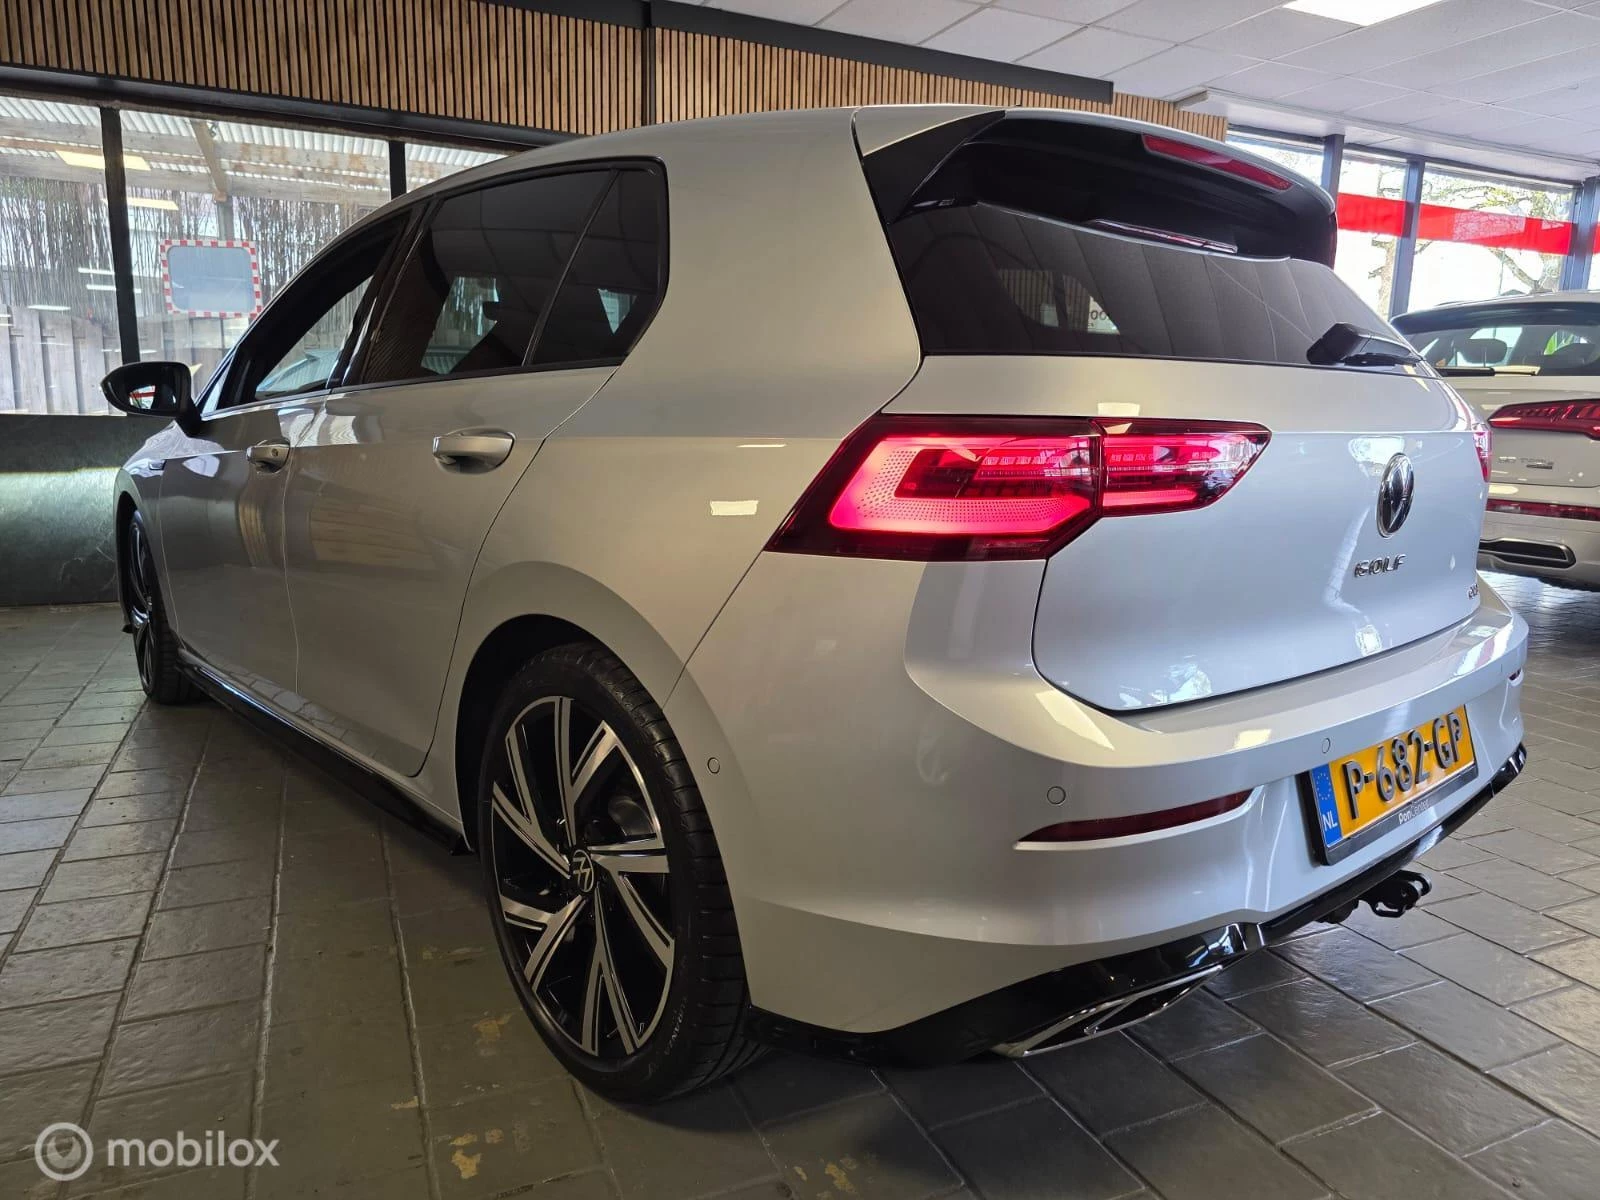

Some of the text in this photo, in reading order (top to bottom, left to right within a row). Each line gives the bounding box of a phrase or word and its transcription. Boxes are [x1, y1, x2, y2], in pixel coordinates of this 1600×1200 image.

[1354, 554, 1407, 578] GOLF
[1343, 711, 1462, 820] P-682-GP
[1322, 812, 1339, 832] NL
